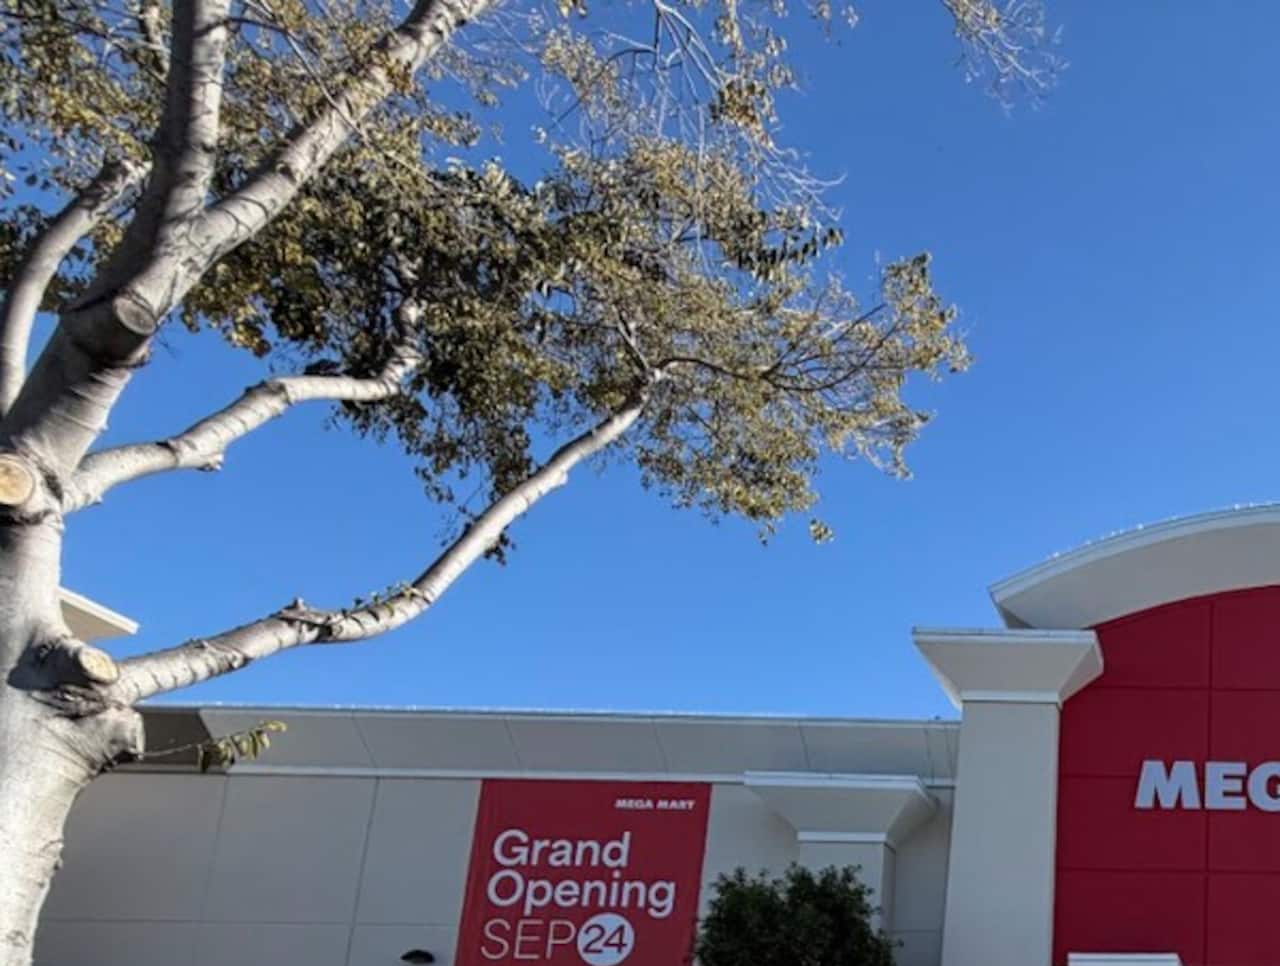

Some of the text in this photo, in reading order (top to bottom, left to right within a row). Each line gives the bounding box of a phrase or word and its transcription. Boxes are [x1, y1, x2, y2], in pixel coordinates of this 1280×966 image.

[614, 798, 696, 811] MEGA MART
[493, 829, 631, 867] Grand
[487, 869, 675, 918] Opening
[481, 918, 628, 960] SEP 24
